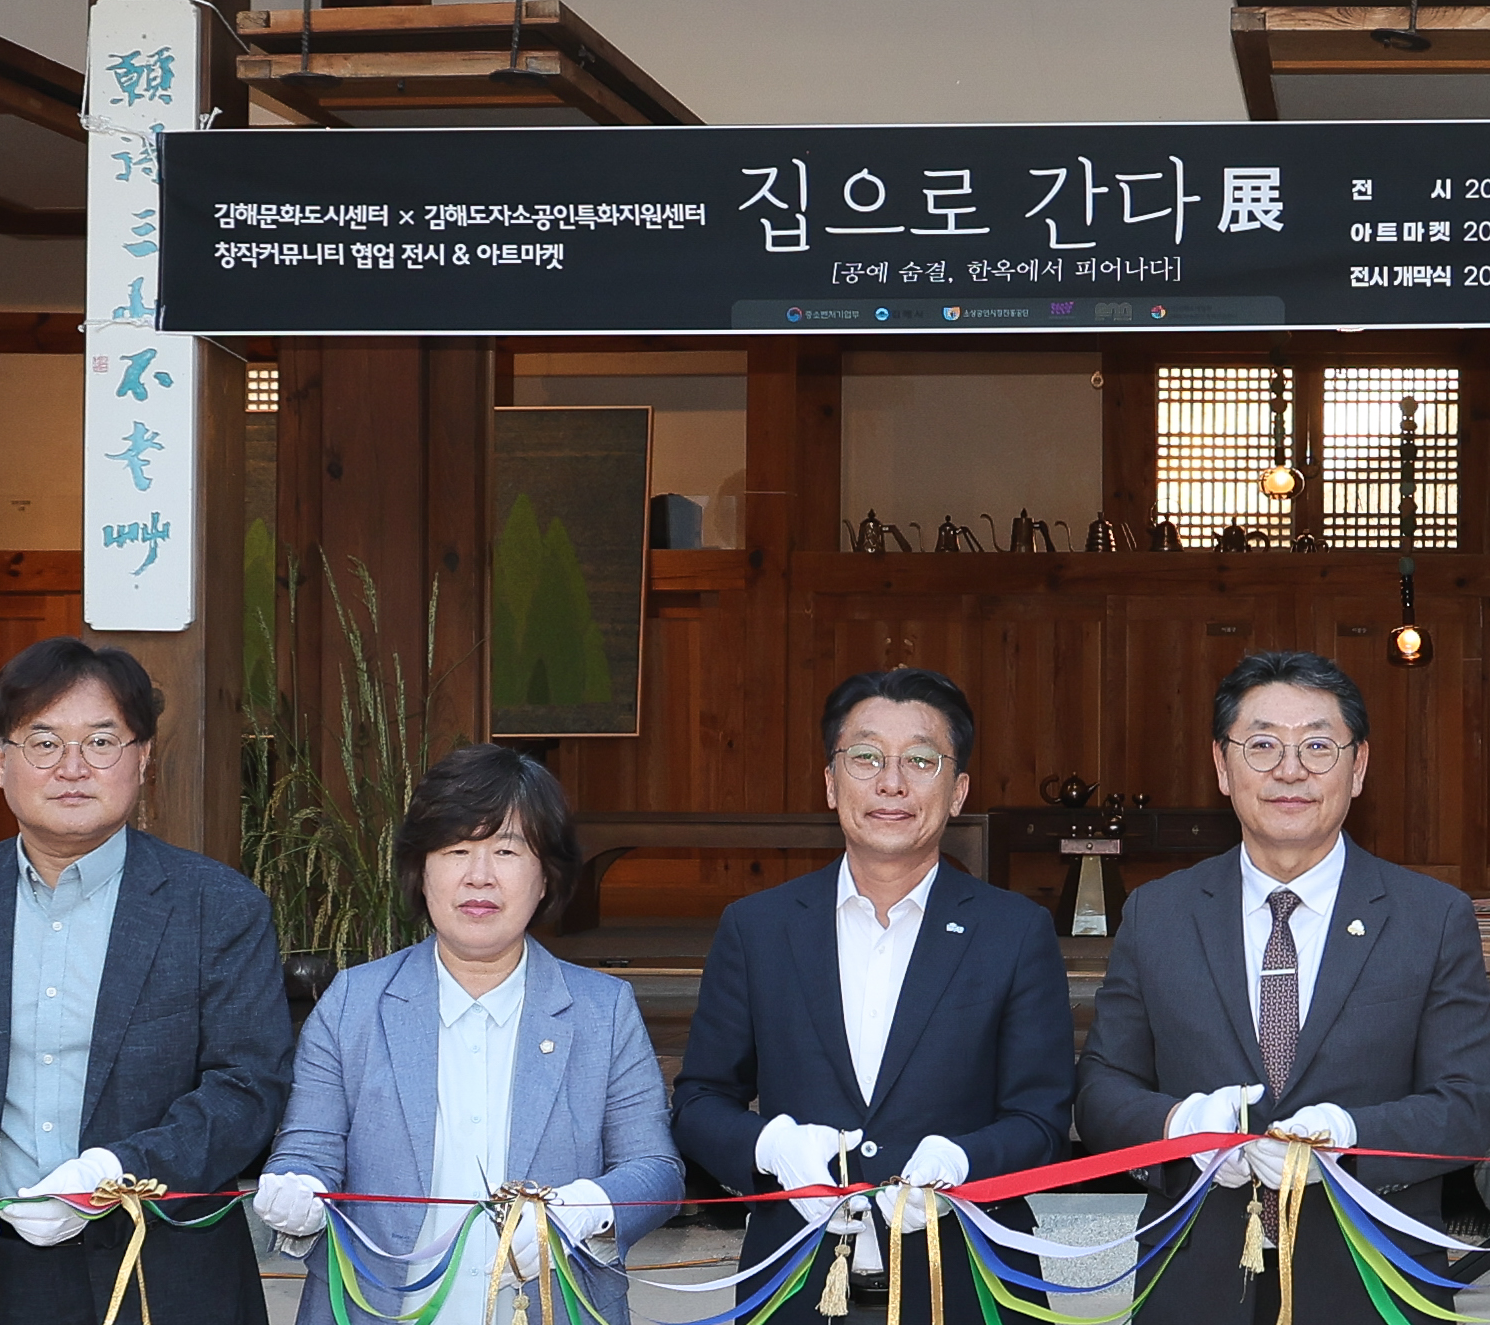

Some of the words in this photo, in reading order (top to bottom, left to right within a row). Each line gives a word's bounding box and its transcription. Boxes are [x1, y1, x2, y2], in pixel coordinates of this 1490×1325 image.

[213, 202, 389, 231] 김해문화도시센터
[423, 202, 706, 232] 김해도자소공인특화지원센터
[738, 157, 991, 253] 집으로
[1024, 155, 1202, 250] 간다
[1217, 166, 1285, 234] 展
[1349, 220, 1451, 243] 아트마켓
[213, 240, 345, 270] 창작커뮤니티
[349, 241, 395, 270] 협업
[400, 242, 446, 270] 전시
[451, 243, 471, 266] &
[476, 242, 565, 270] 아트마켓
[831, 261, 889, 285] [공예
[898, 260, 954, 284] 숨결,
[967, 257, 1063, 283] 한옥에서
[1075, 256, 1181, 282] 피어나다]
[1349, 265, 1389, 288] 전시
[1392, 264, 1452, 288] 개막식
